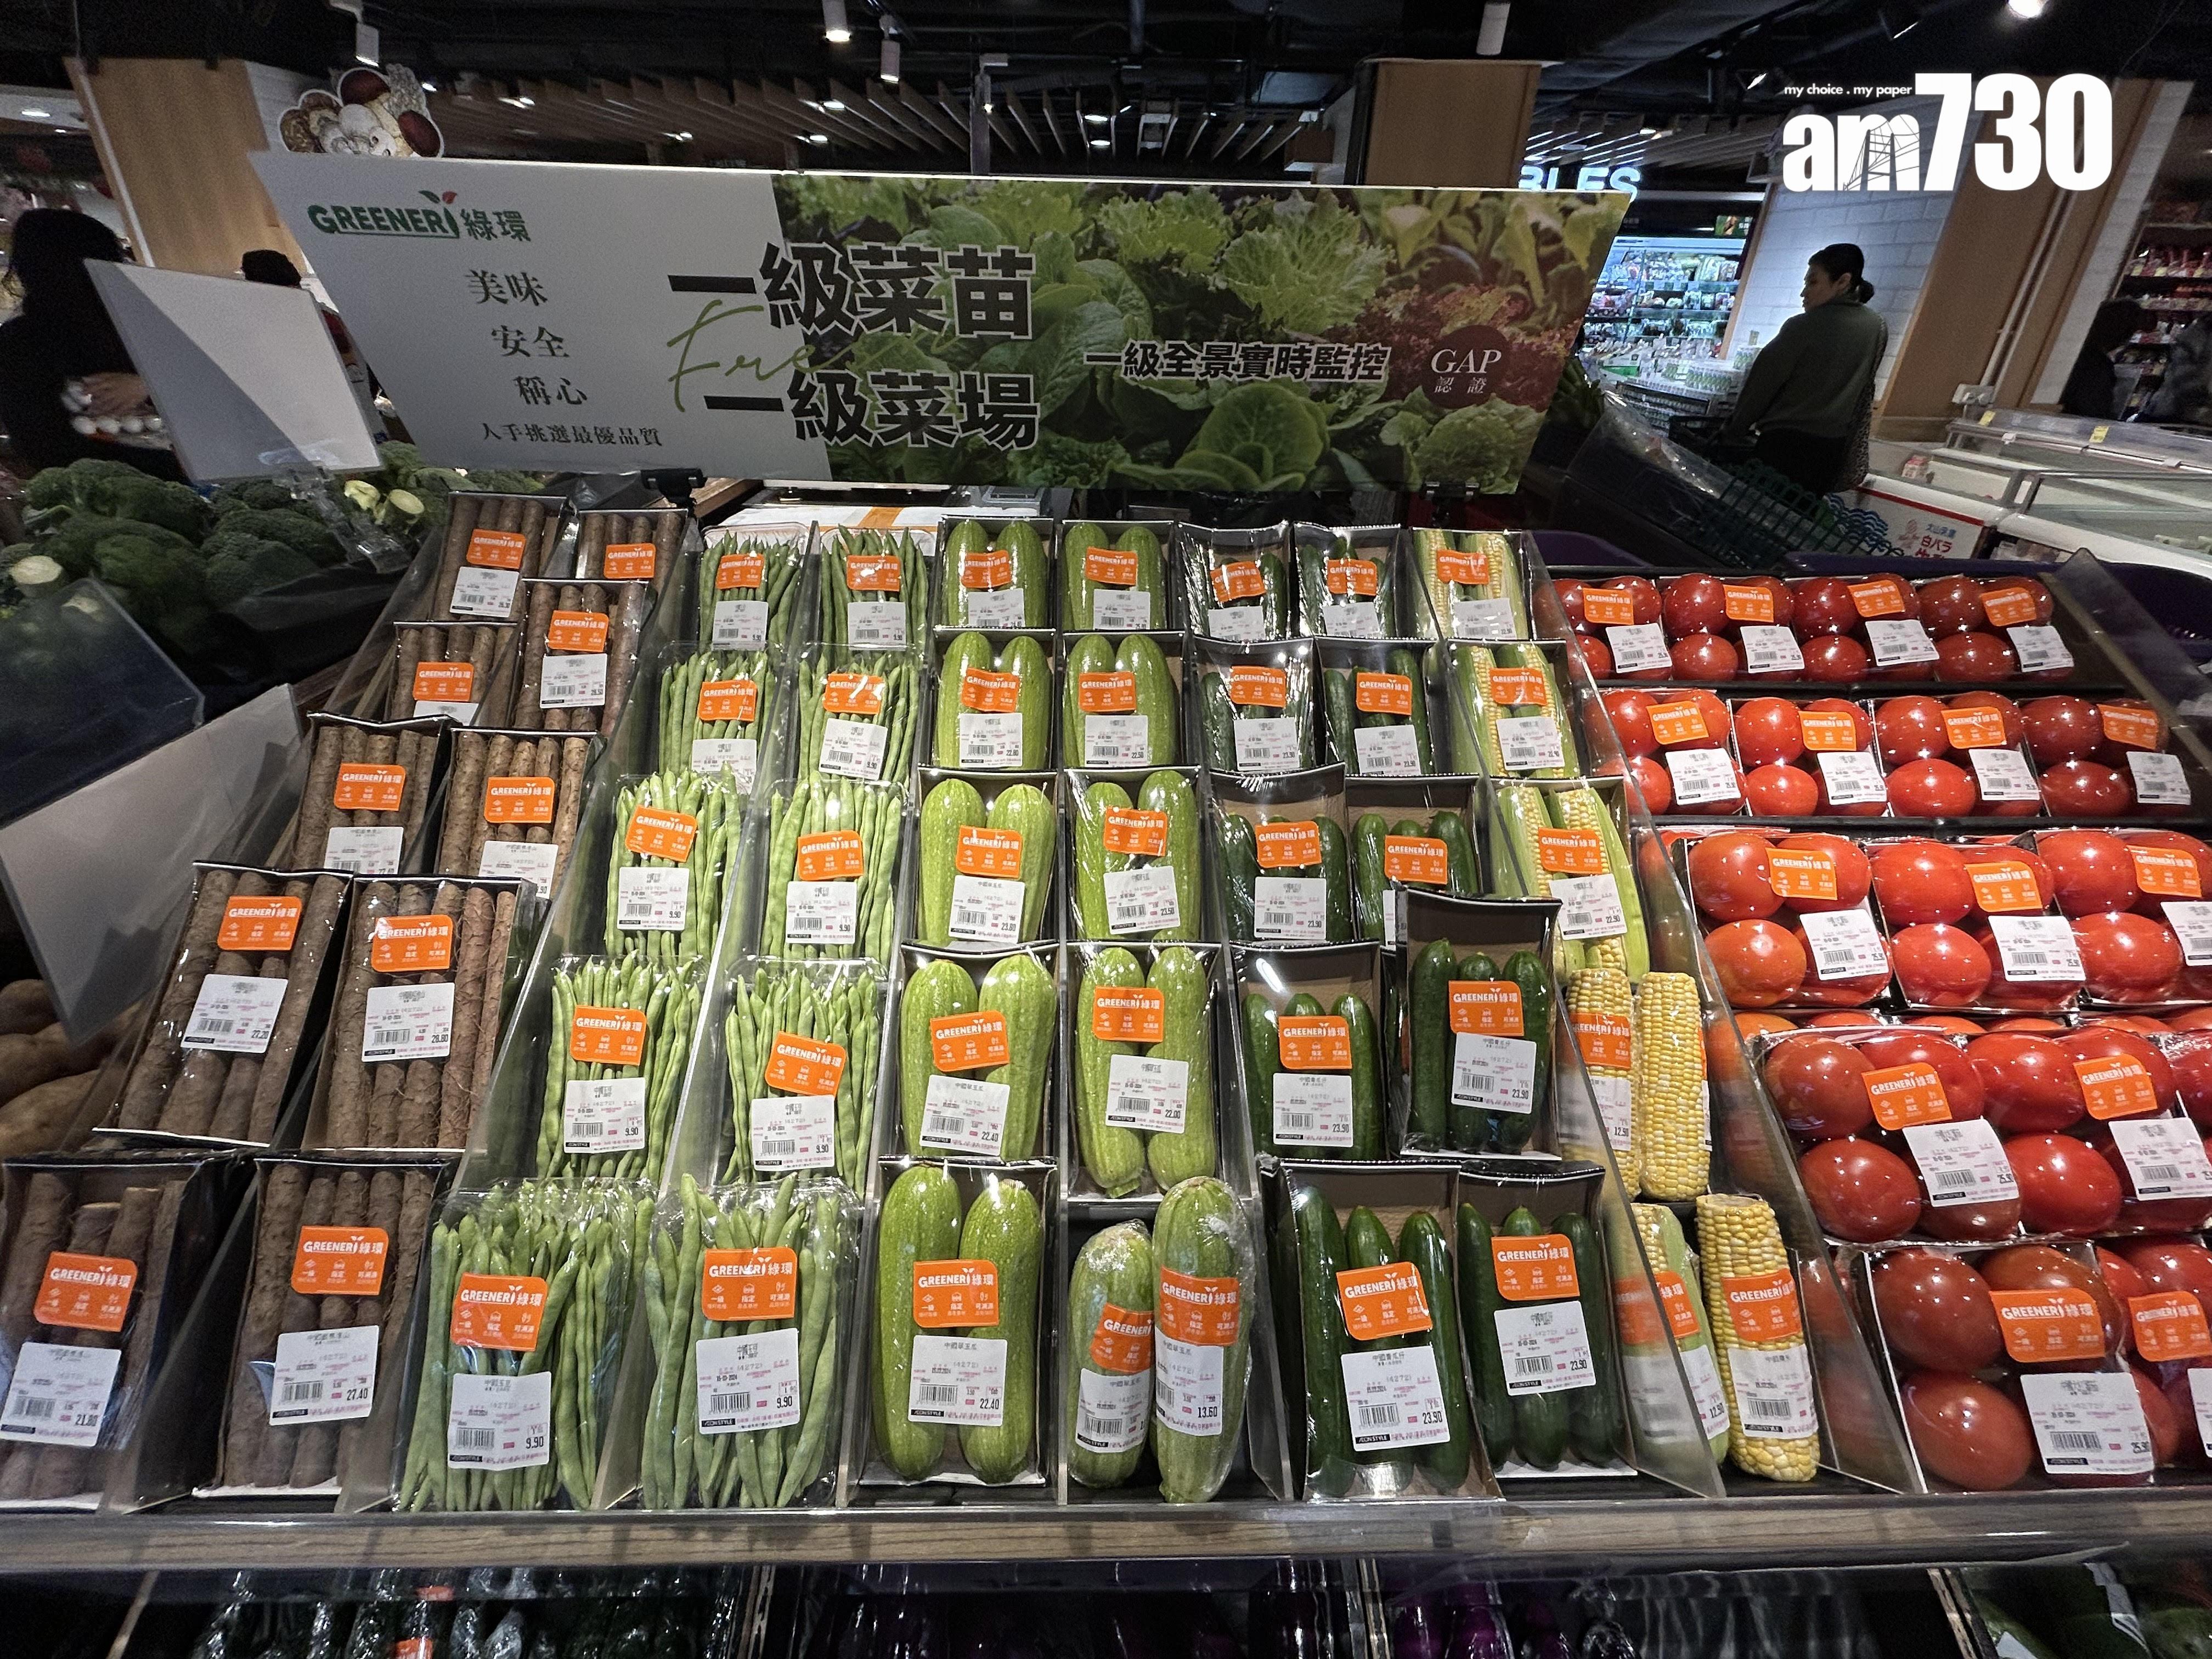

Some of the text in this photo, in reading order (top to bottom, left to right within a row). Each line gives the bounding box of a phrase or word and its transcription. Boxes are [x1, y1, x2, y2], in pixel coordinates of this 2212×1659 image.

[461, 207, 532, 242] 綠環
[466, 270, 548, 306] 美味
[668, 241, 1036, 340] 一級菜苗
[492, 326, 570, 360] 安全
[1084, 340, 1391, 382] 一級全景實時監控
[1431, 348, 1503, 376] GAP
[514, 376, 588, 407] 稱心
[703, 369, 1040, 452] 一級菜場
[482, 422, 663, 447] 人手挑選最優品質
[821, 1053, 842, 1067] 綠環
[1512, 1090, 1528, 1099] 23.90
[625, 1127, 639, 1136] 9.90
[981, 1132, 998, 1141] 22.40
[816, 1145, 828, 1153] 9.90
[768, 1262, 793, 1276] 綠環
[972, 1273, 994, 1286] 綠環
[516, 1293, 543, 1307] 綠環
[1214, 1290, 1236, 1305] 綠環
[1570, 1360, 1587, 1370] 23.90
[346, 1389, 368, 1400] 27.40
[776, 1396, 793, 1408] 9.90
[980, 1399, 999, 1409] 22.40
[1198, 1406, 1217, 1418] 13.60
[1423, 1412, 1442, 1423] 23.90
[526, 1437, 544, 1448] 9.90
